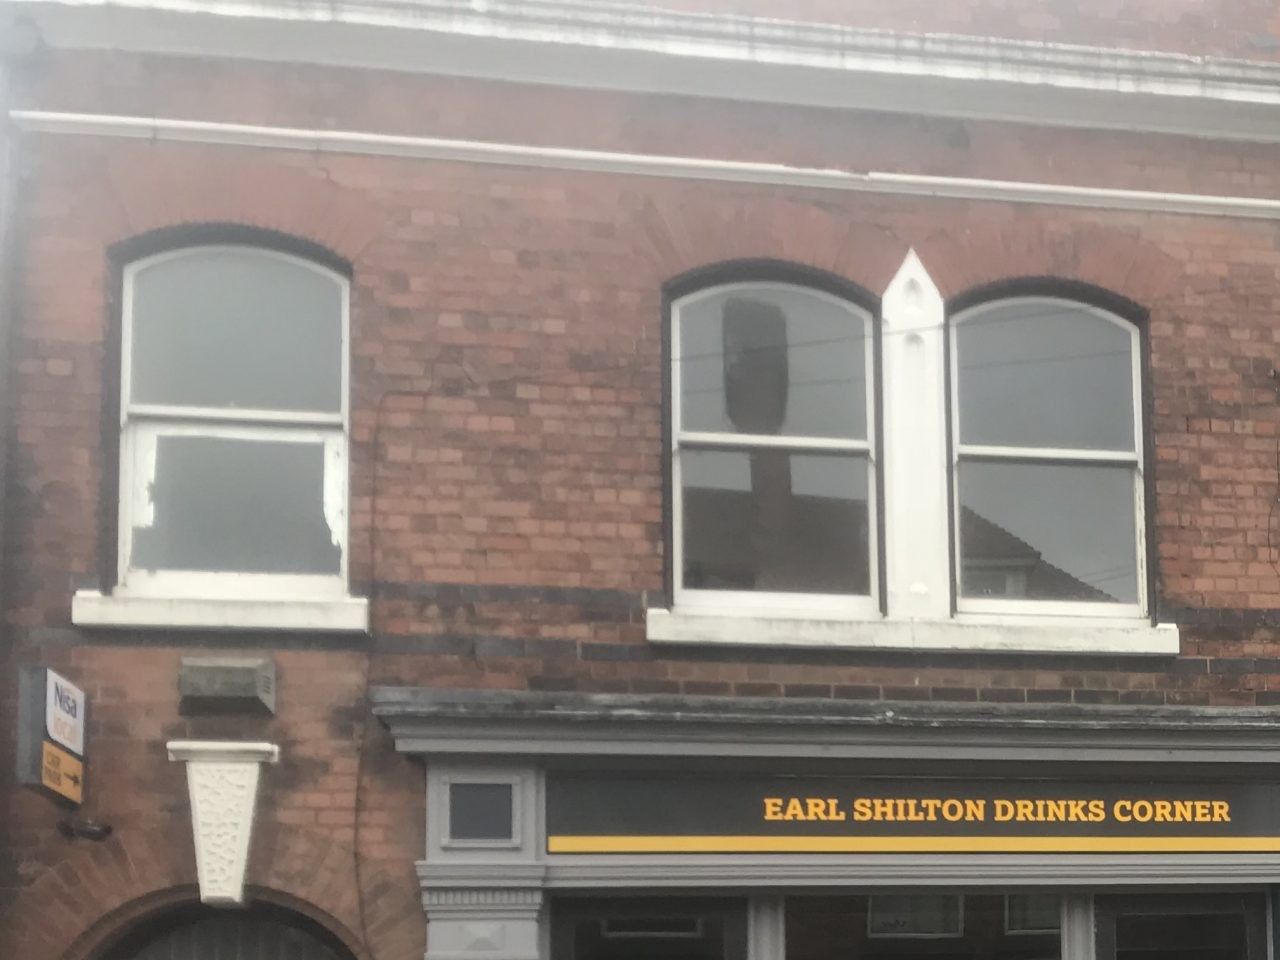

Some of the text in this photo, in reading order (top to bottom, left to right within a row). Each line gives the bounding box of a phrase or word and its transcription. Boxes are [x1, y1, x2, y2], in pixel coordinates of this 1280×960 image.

[54, 682, 78, 720] Nisa
[764, 798, 1231, 822] EARL SHILTON DRINKS CORNER
